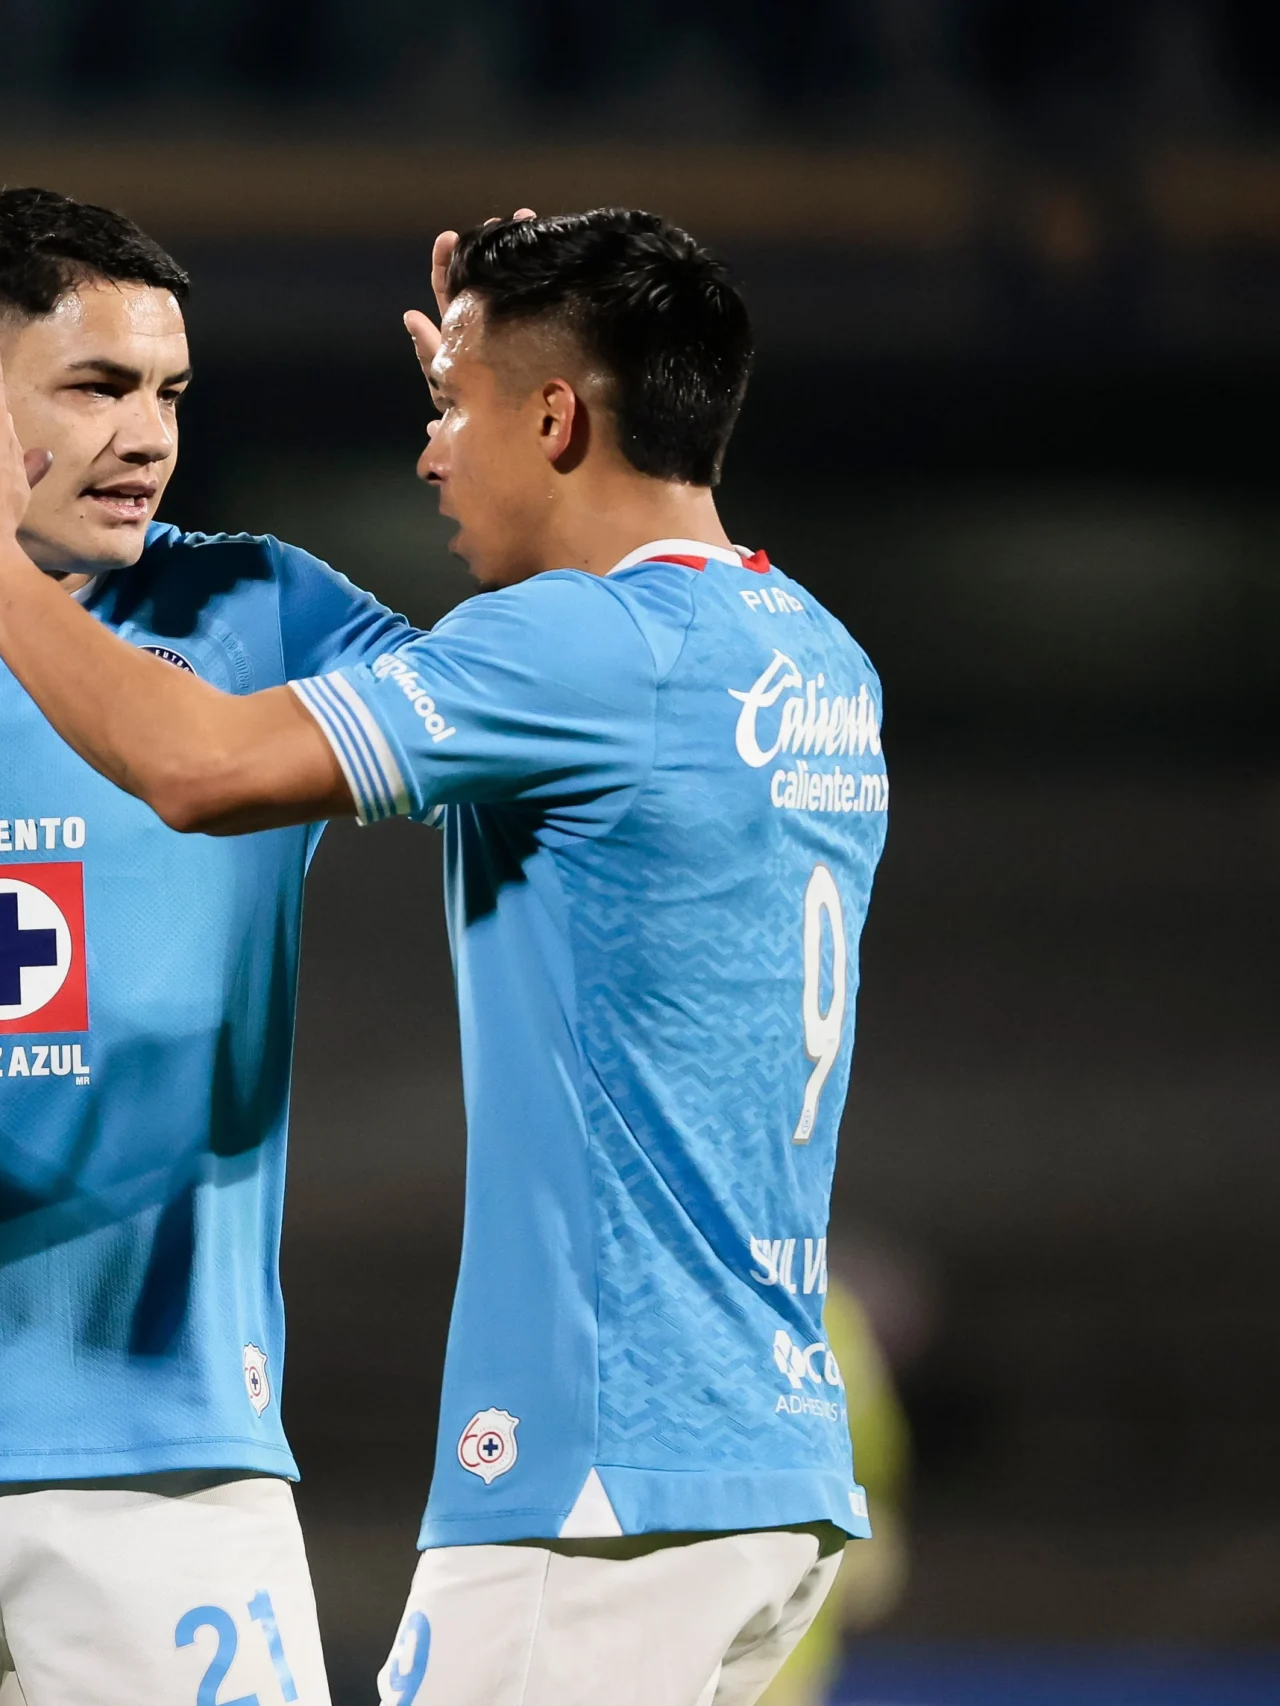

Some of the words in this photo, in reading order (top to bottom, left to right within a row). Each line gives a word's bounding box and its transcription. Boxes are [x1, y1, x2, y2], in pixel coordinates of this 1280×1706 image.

[154, 649, 190, 673] FUTBO
[792, 861, 847, 1146] 9
[8, 1044, 90, 1077] AZUL
[75, 1075, 91, 1086] MR
[174, 1587, 299, 1706] 21
[388, 1610, 431, 1706] 9
